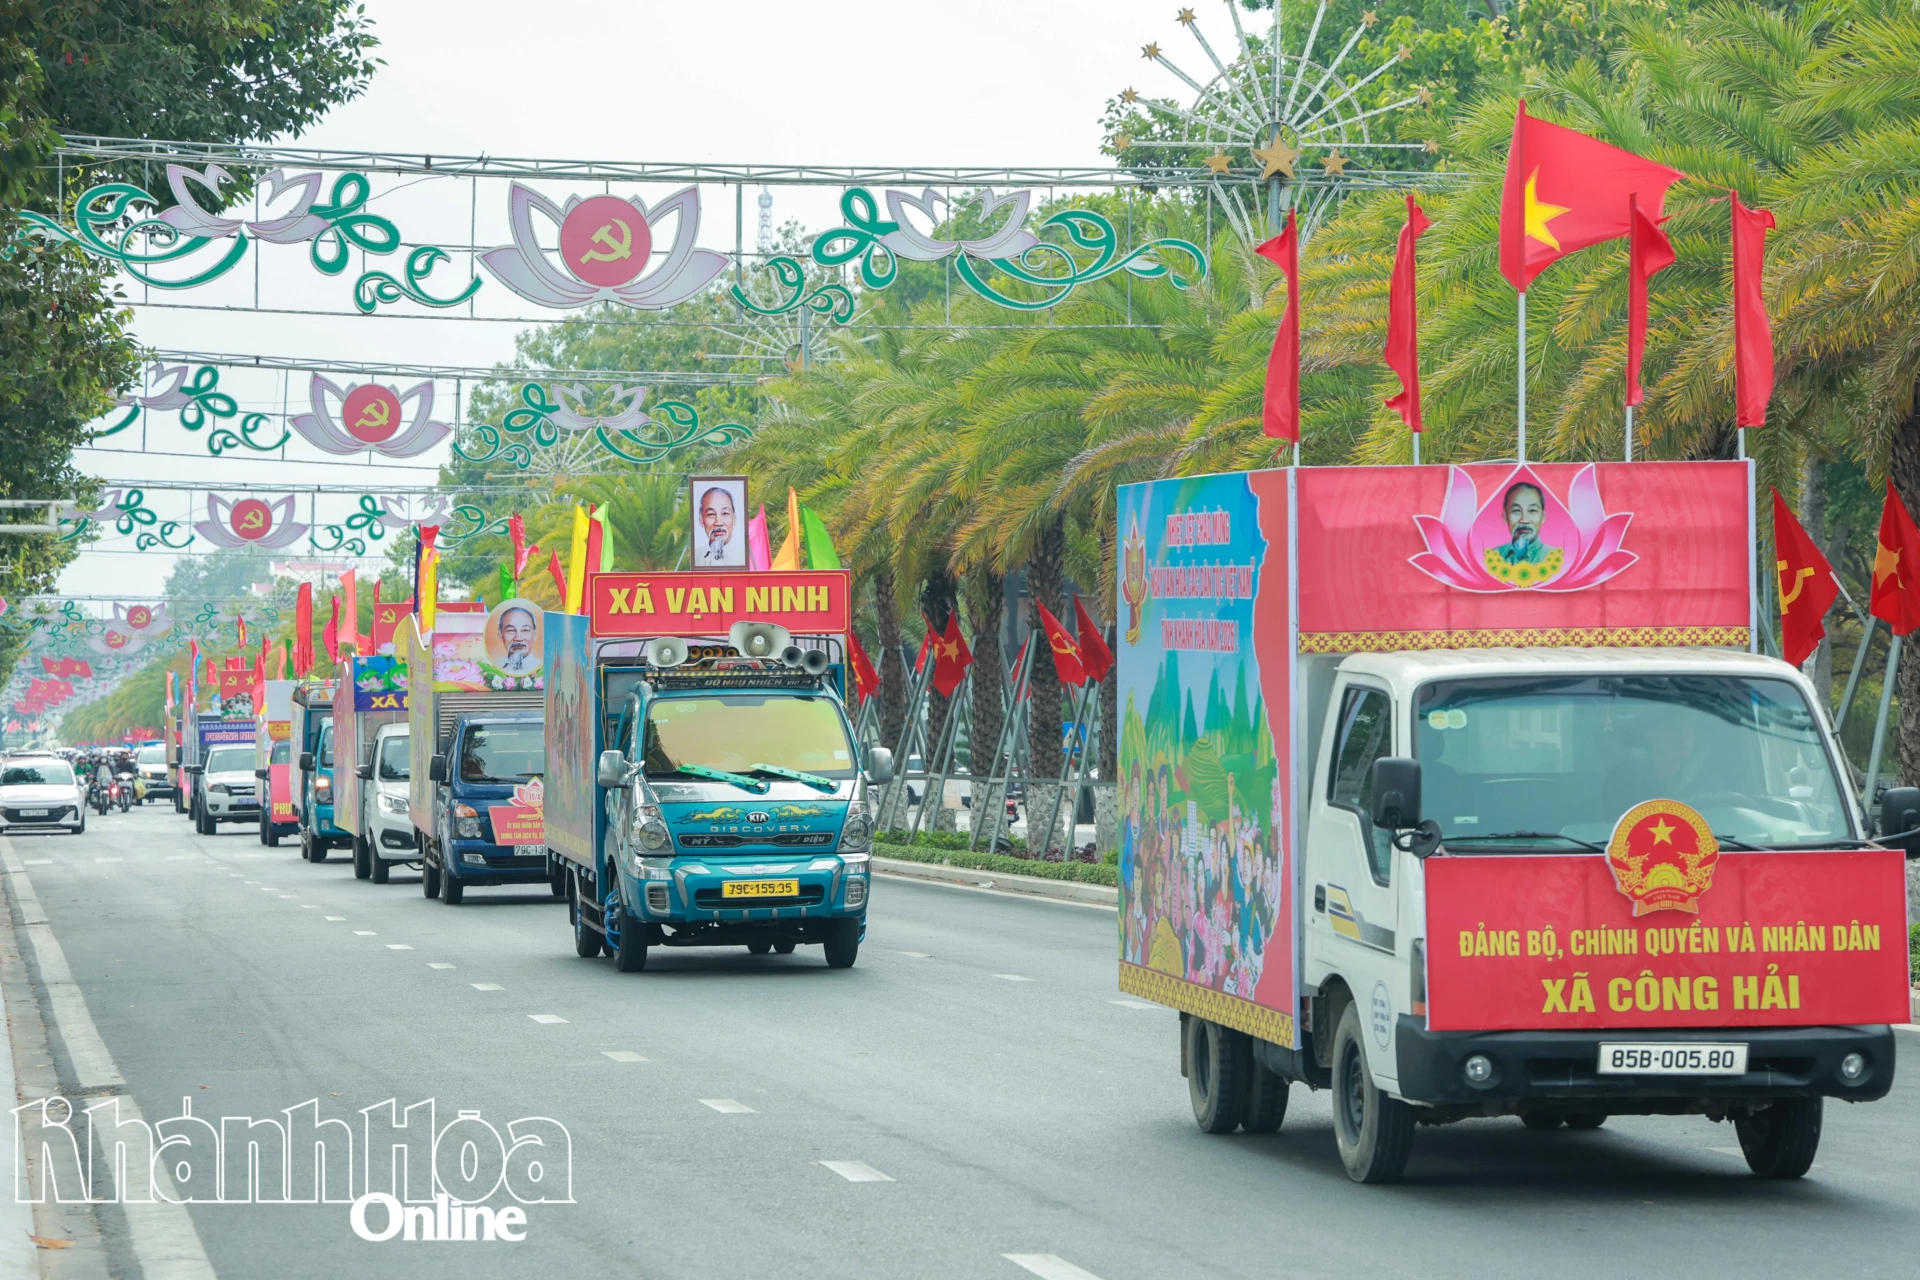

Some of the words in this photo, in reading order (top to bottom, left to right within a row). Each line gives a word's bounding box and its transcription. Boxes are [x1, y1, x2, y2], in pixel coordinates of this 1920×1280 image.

[608, 582, 656, 614] XÃ
[664, 587, 734, 620] VẠN
[746, 585, 828, 613] NINH
[370, 693, 400, 709] XÃ
[710, 825, 811, 833] DISCOVERY
[728, 882, 793, 895] 79C-155.35
[1459, 921, 1520, 957] ĐẢNG
[1527, 924, 1563, 962] BỘ,
[1570, 924, 1638, 956] CHÍNH
[1645, 918, 1720, 957] QUYỀN
[1725, 921, 1756, 953] VÀ
[1762, 920, 1825, 952] NHÂN
[1832, 919, 1881, 952] DÂN
[1541, 971, 1596, 1013] XÃ
[1608, 969, 1719, 1012] CÔNG
[1732, 963, 1800, 1010] HẢI
[1612, 1049, 1734, 1069] 85B-005.80
